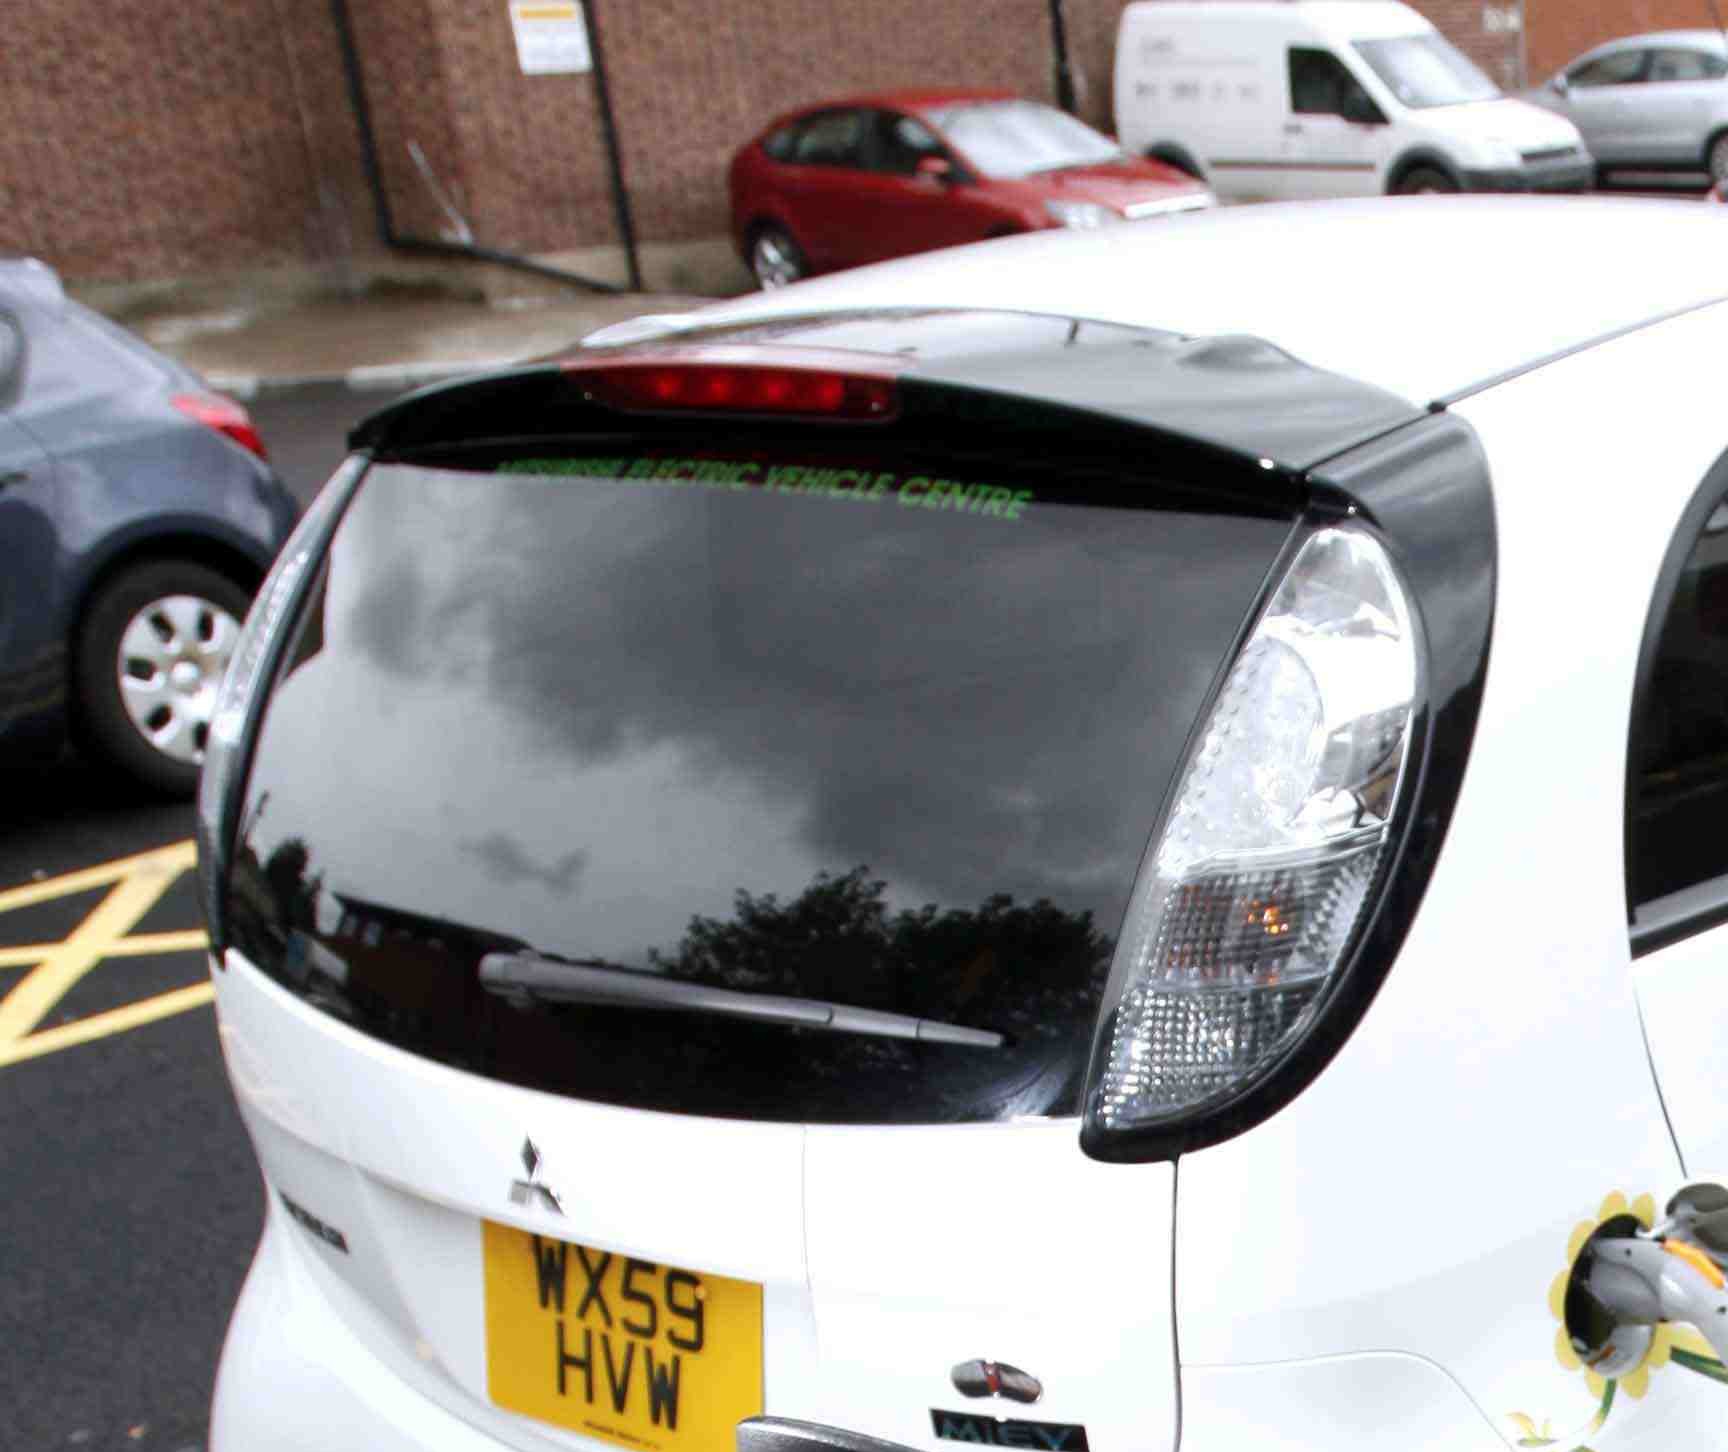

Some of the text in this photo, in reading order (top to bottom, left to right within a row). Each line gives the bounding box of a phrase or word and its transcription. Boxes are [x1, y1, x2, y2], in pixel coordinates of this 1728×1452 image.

[764, 464, 896, 501] VEHICLE
[898, 476, 1033, 520] CENTRE
[532, 1233, 704, 1354] WX59
[556, 1318, 680, 1433] HVW
